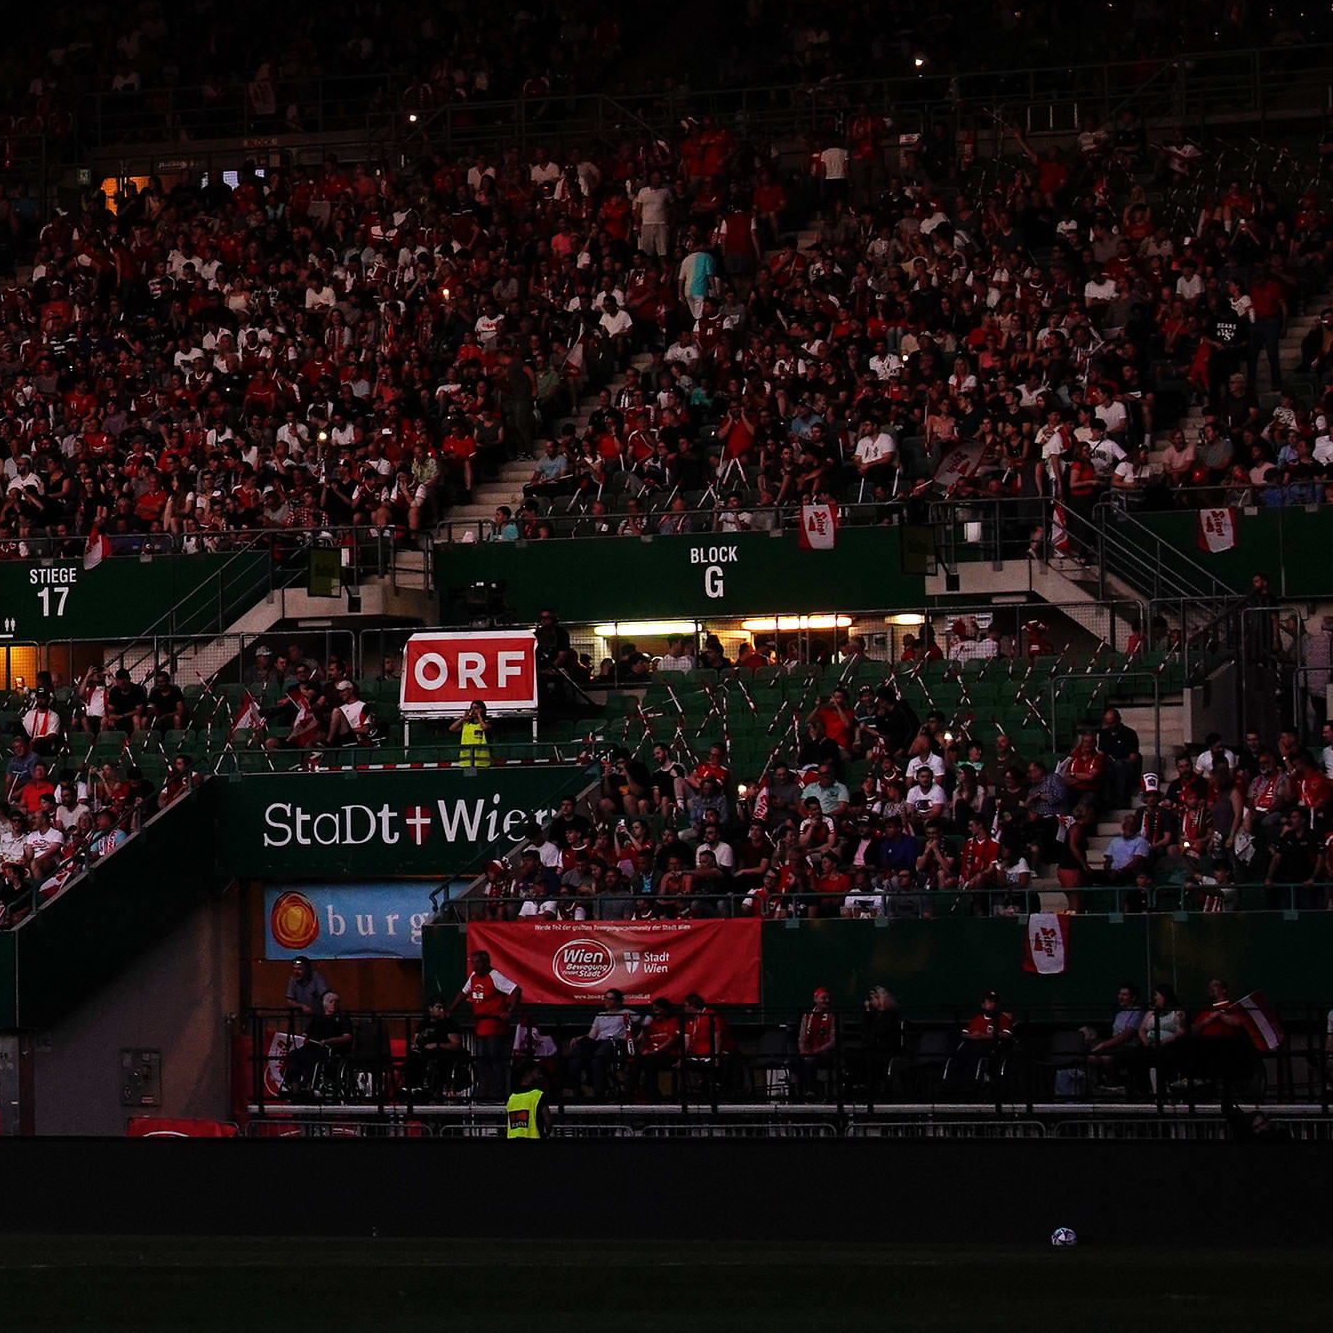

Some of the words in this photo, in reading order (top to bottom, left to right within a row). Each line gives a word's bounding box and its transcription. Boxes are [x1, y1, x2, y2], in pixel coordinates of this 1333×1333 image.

[690, 545, 739, 564] BLOCK
[29, 567, 78, 584] STIEGE
[704, 565, 724, 599] G
[37, 587, 70, 617] 17
[414, 651, 525, 691] ORF
[263, 802, 401, 848] StaDt
[563, 949, 604, 963] Wien
[644, 951, 670, 963] Stadt
[579, 970, 602, 978] Stadt
[643, 963, 669, 974] Wien
